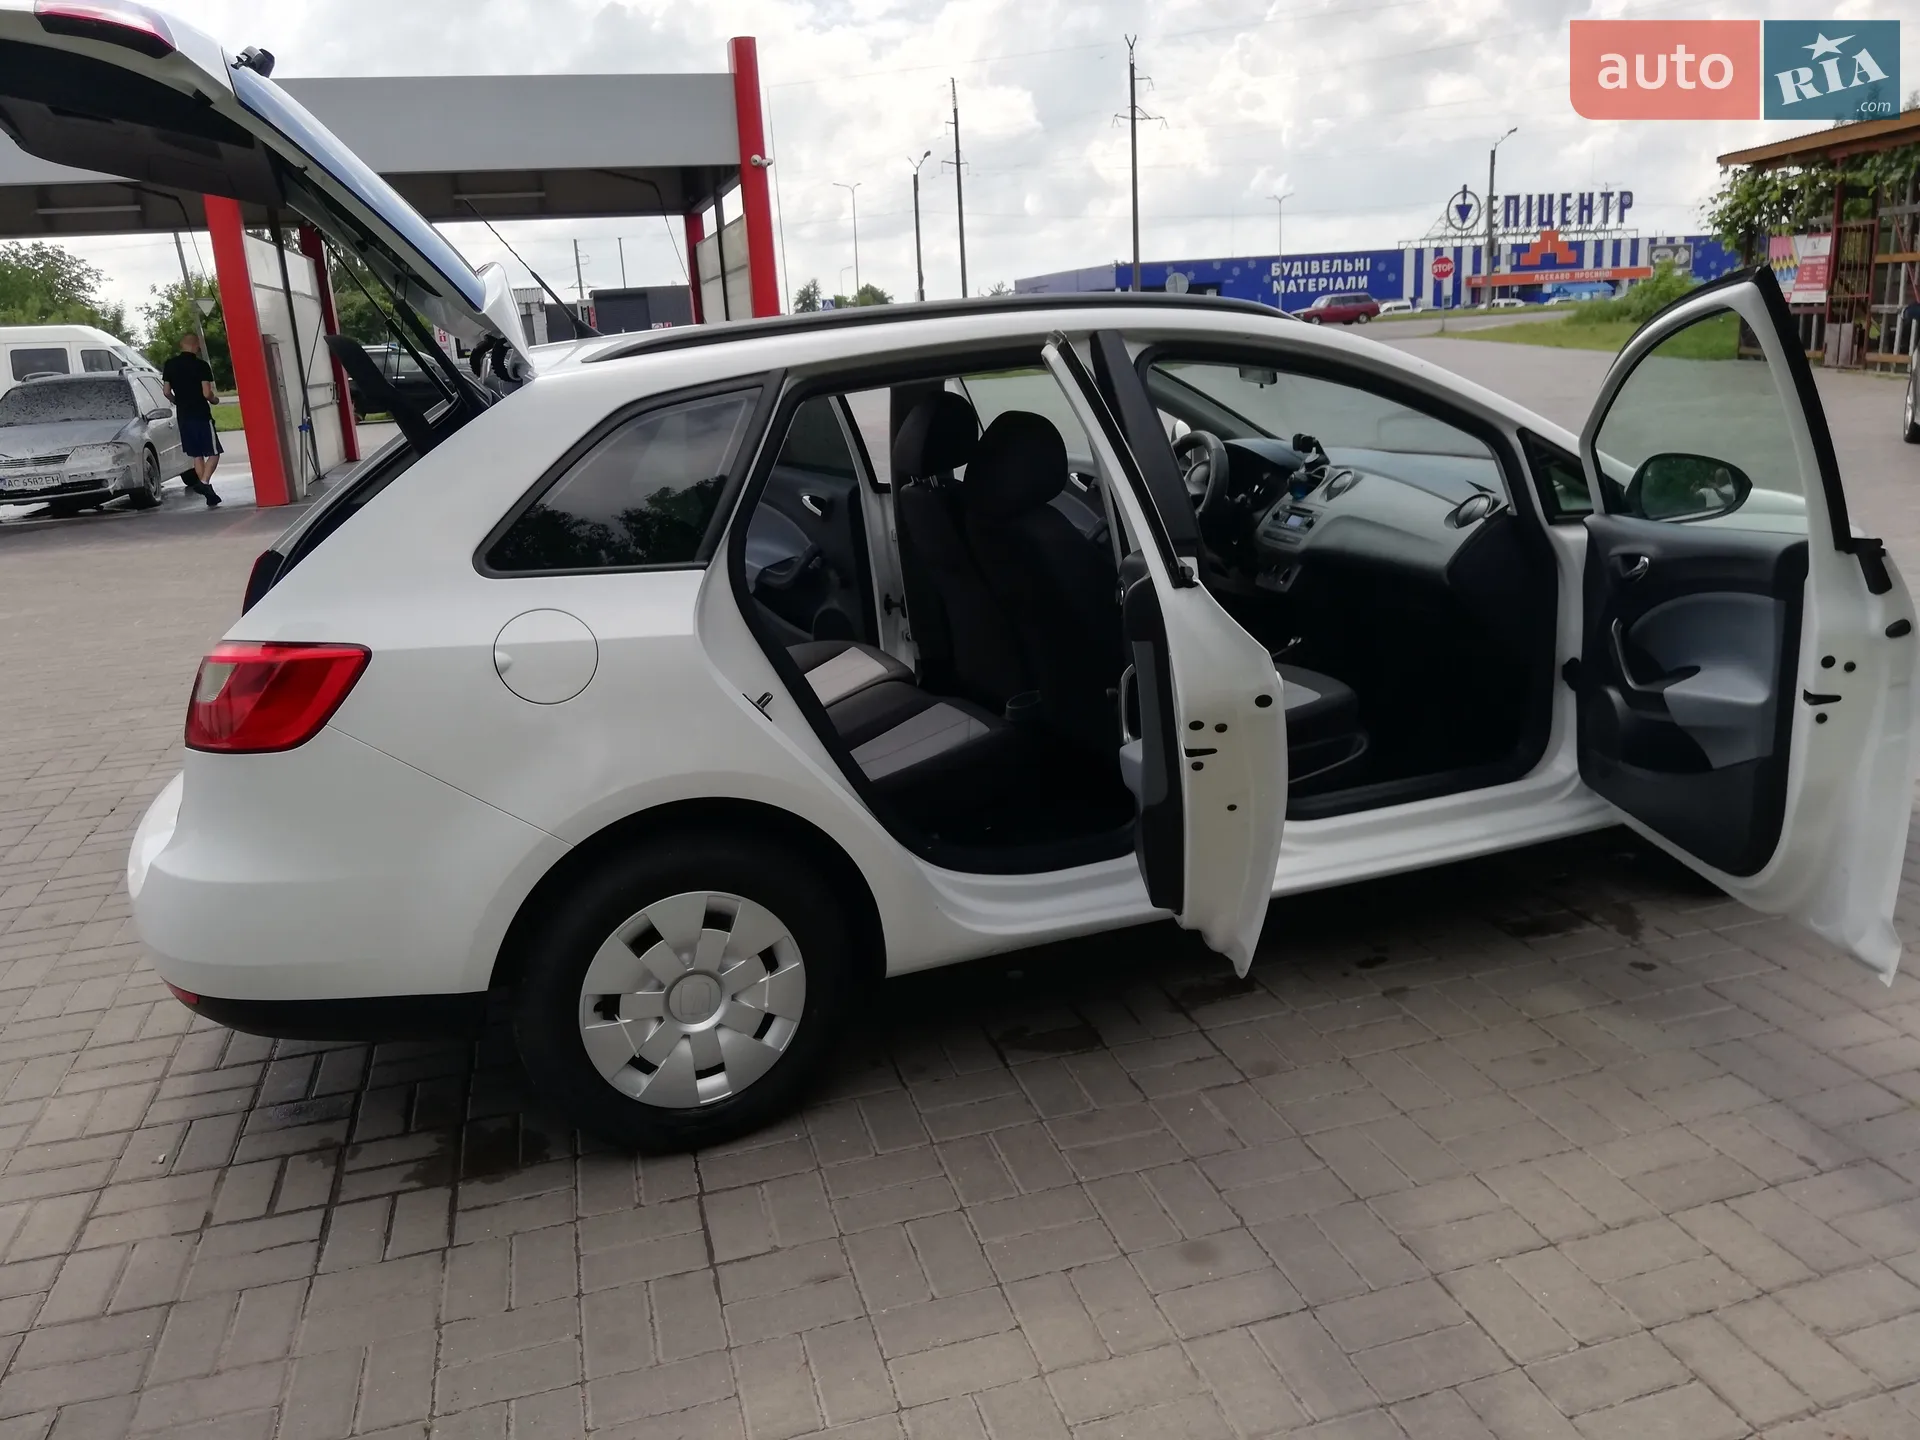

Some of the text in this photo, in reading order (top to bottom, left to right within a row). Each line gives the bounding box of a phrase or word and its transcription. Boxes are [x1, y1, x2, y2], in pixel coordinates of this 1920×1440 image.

[1487, 191, 1633, 229] ЕПІЦЕНТР
[1271, 257, 1371, 277] БУДІВЕЛЬНІ
[1432, 263, 1453, 274] STOP
[1534, 272, 1570, 281] ЛАСКАВО
[1272, 275, 1368, 294] МАТЕРІАЛИ
